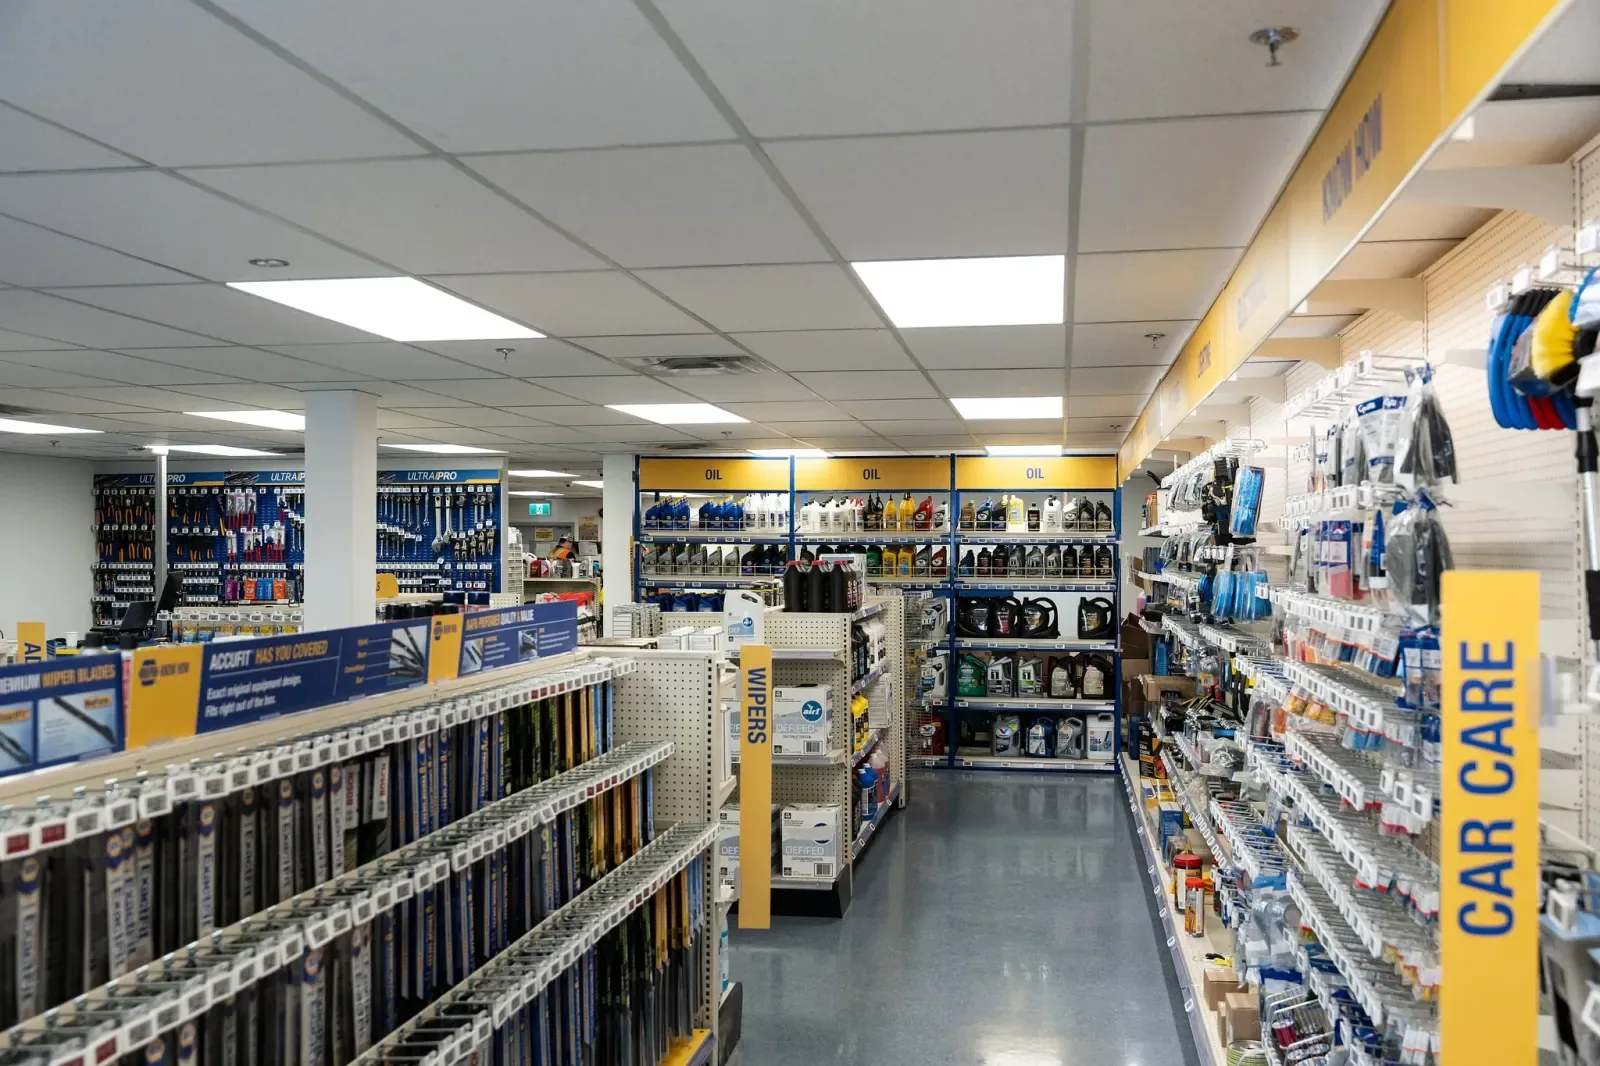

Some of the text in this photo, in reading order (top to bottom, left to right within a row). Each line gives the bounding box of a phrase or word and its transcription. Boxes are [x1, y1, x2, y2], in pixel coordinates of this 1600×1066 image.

[705, 468, 723, 480] OIL
[863, 468, 881, 480] OIL
[1026, 467, 1045, 479] OIL
[255, 645, 275, 665] HAS
[275, 643, 292, 661] YOU
[293, 639, 329, 659] COVERED
[747, 667, 767, 744] WIPERS
[1458, 640, 1515, 936] CAR CARE
